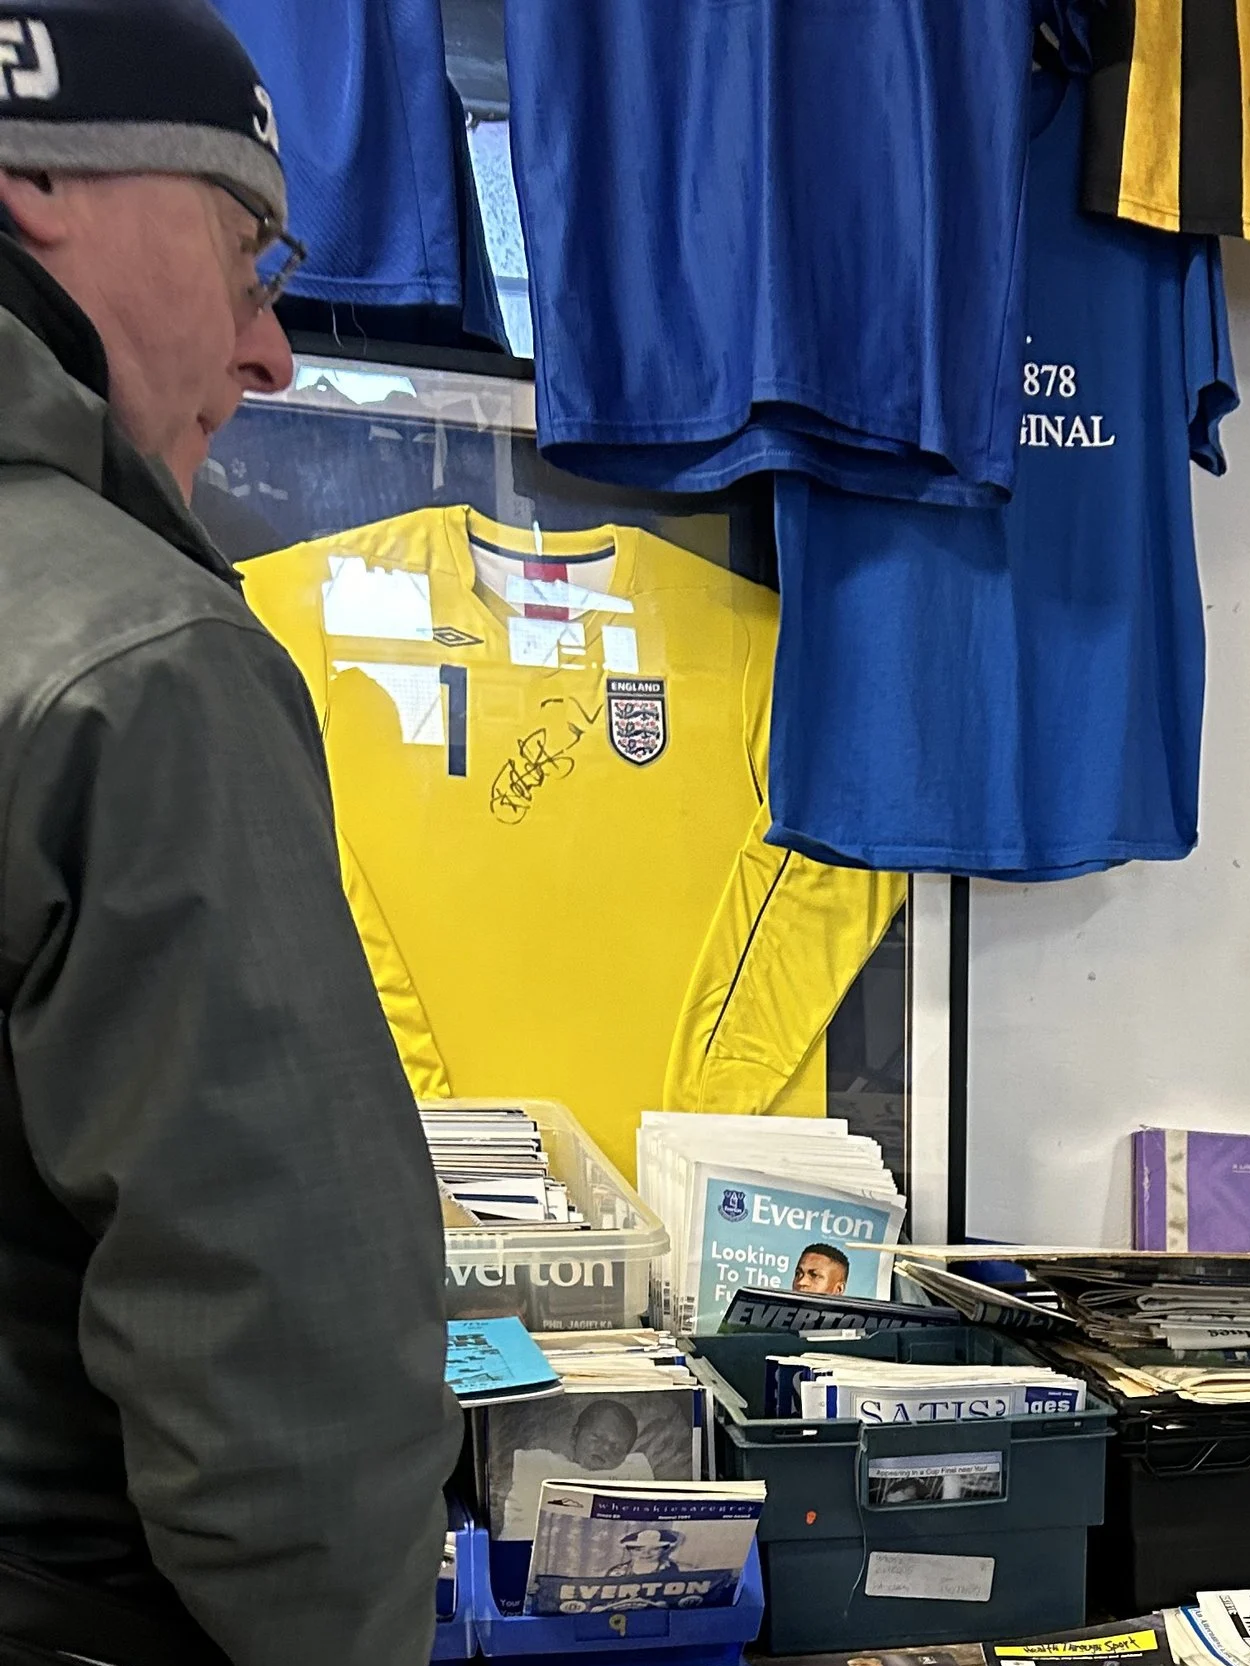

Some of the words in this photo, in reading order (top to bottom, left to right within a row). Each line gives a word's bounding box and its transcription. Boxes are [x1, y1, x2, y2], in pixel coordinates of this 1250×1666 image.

[610, 681, 661, 693] ENGLAND
[752, 1193, 874, 1240] Everton
[712, 1241, 789, 1273] Looking
[446, 1256, 614, 1287] verton
[717, 1263, 739, 1283] To
[746, 1266, 781, 1289] The
[876, 1467, 911, 1479] Appearing
[925, 1467, 940, 1477] Cup
[940, 1465, 957, 1475] Final
[560, 1581, 711, 1600] EVERTON
[1105, 1636, 1141, 1653] Sport
